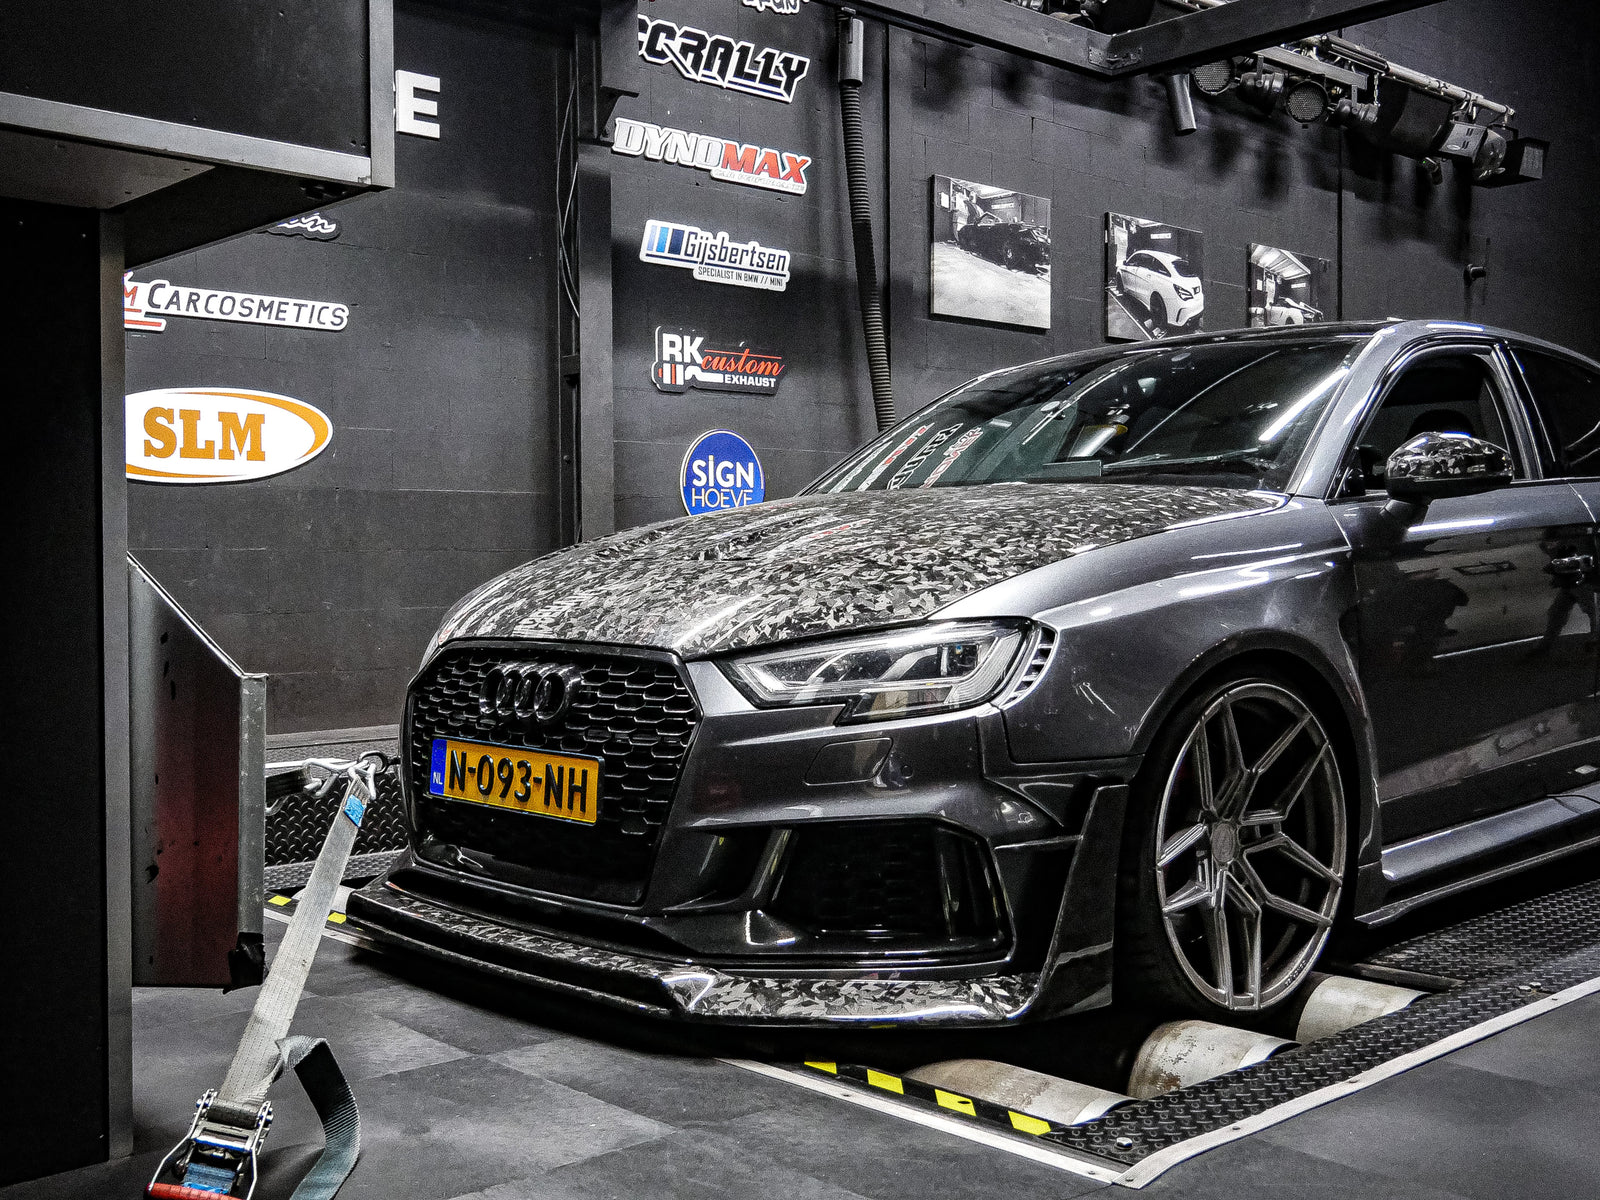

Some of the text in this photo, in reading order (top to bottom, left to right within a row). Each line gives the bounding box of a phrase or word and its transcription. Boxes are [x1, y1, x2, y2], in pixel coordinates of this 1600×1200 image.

[613, 119, 810, 185] DYNOMAX
[684, 231, 786, 271] Gijsbertsen
[698, 266, 734, 280] SPECIALIST
[735, 271, 742, 280] IN
[744, 273, 759, 284] BMW
[770, 276, 783, 287] MINI
[662, 333, 704, 364] RK
[701, 348, 785, 376] custom
[724, 373, 776, 388] EXHAUST
[143, 407, 265, 462] SLM
[432, 771, 443, 785] NL
[449, 750, 588, 813] N-093-NH
